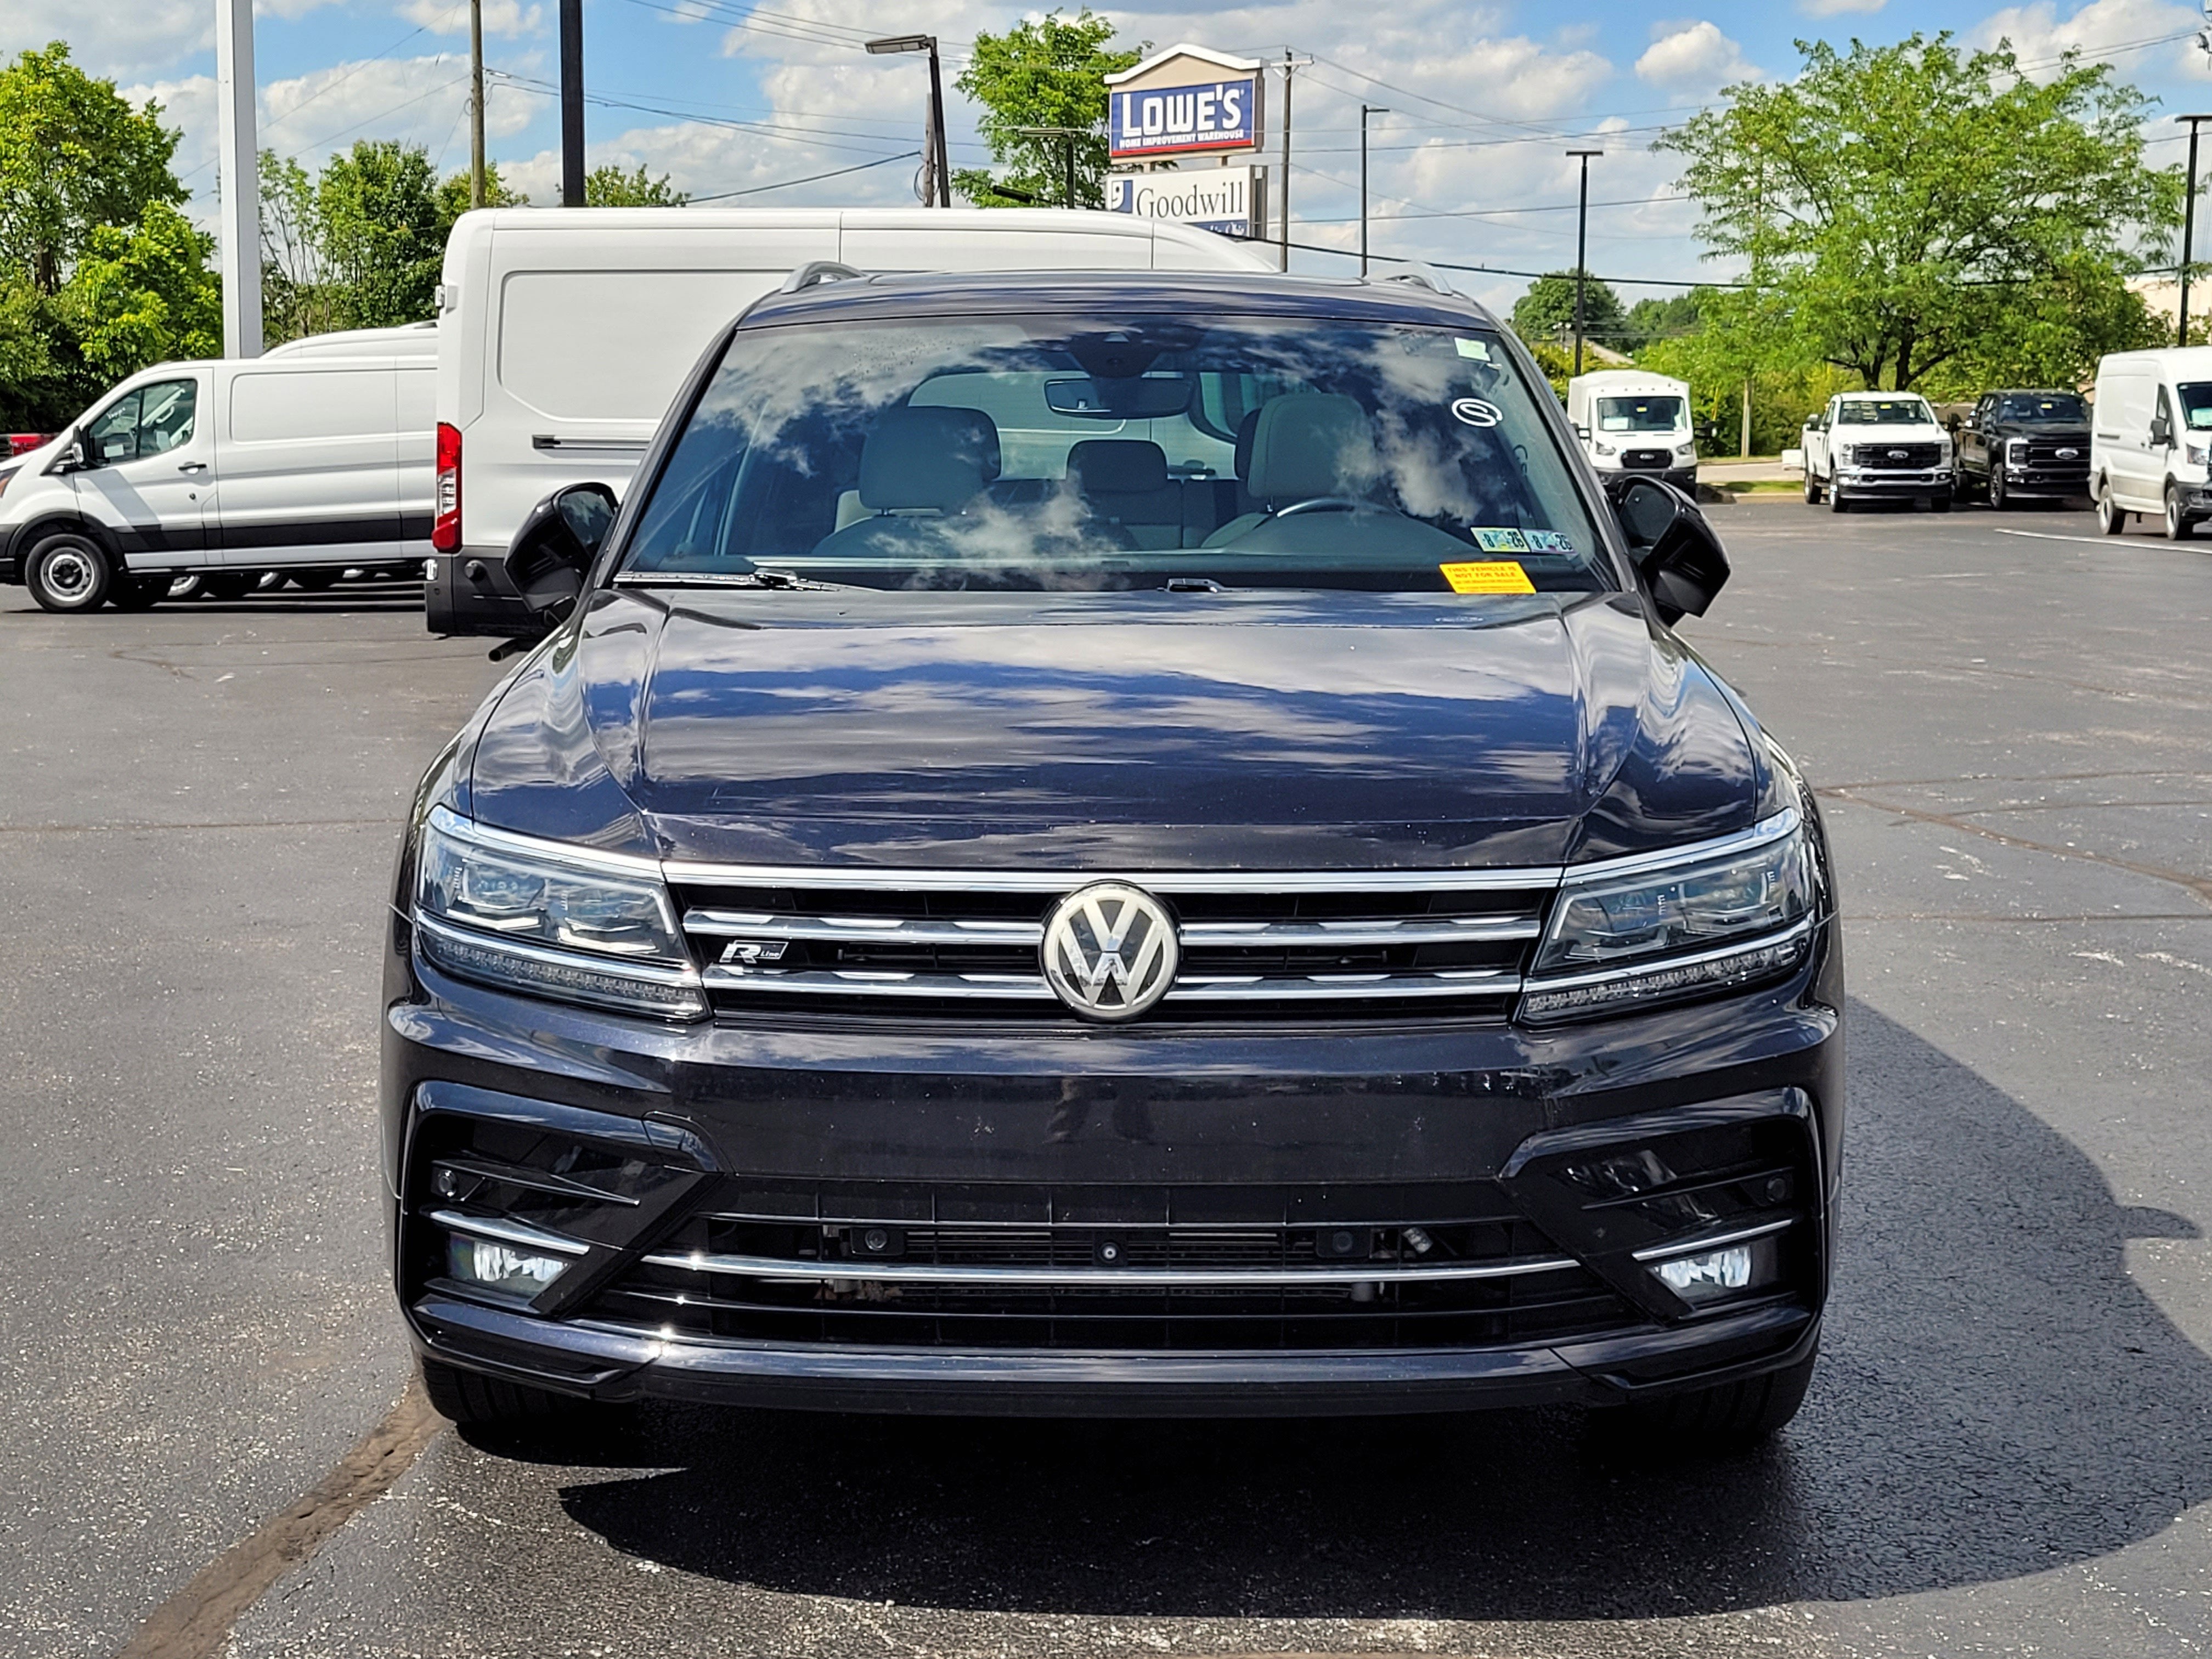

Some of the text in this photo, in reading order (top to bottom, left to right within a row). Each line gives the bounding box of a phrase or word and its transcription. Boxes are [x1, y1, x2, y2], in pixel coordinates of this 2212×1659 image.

[1122, 84, 1241, 137] LOWE'S
[1120, 129, 1244, 148] HOME IMPROVEMENT WAREHOUSE
[1137, 181, 1243, 218] Goodwill
